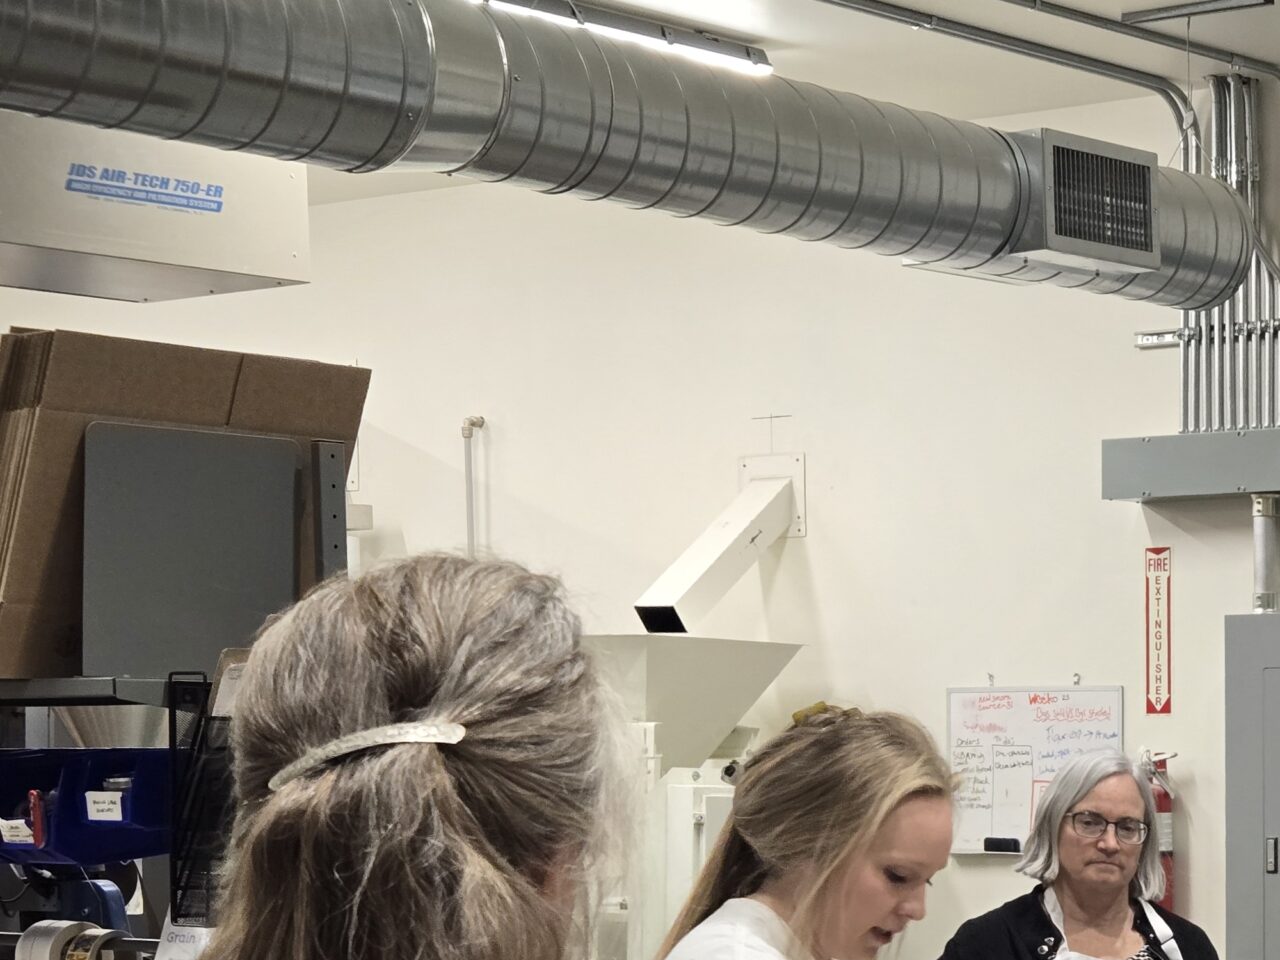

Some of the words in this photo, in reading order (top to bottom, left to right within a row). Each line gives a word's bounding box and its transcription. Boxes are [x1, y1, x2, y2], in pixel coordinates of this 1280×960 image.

[67, 162, 97, 178] JDS
[99, 167, 170, 190] AIR-TECH
[173, 178, 223, 198] 750-ER
[1148, 557, 1168, 572] FIRE
[167, 931, 195, 944] Grain
